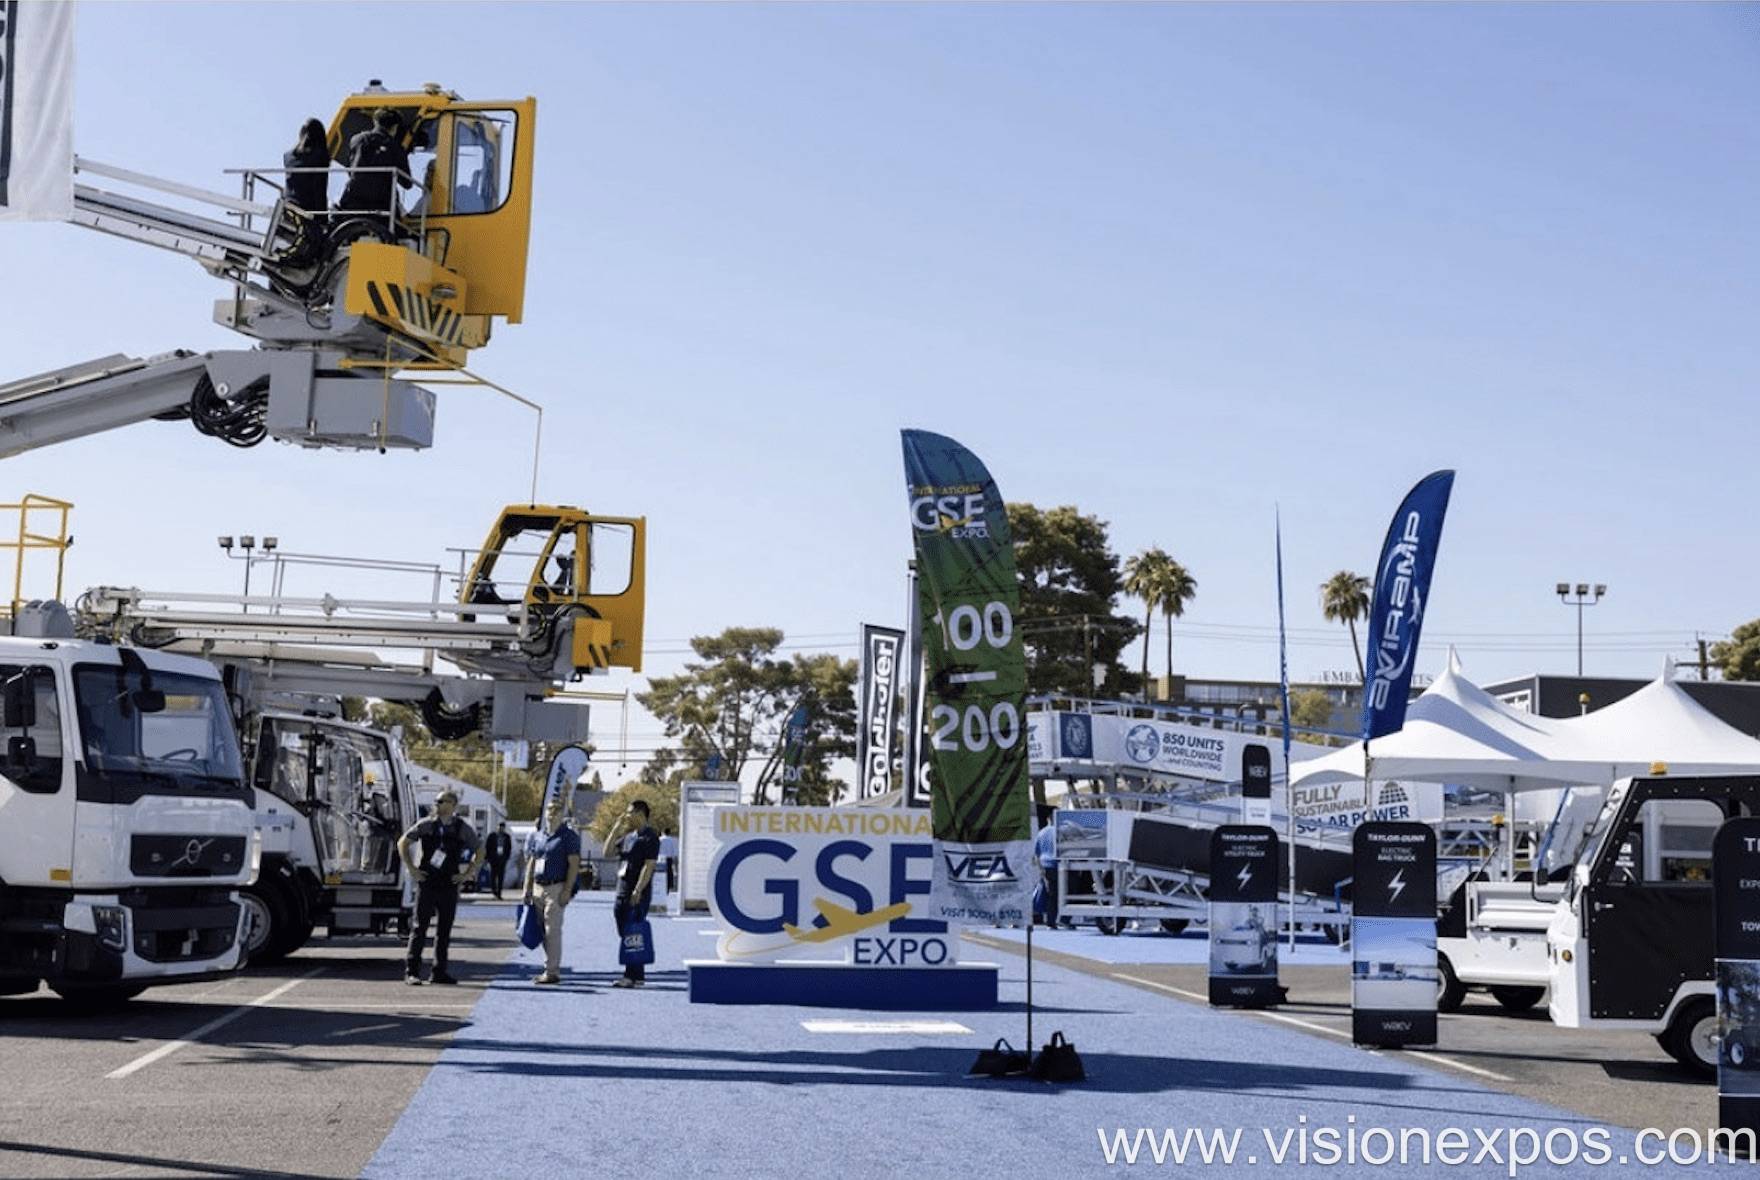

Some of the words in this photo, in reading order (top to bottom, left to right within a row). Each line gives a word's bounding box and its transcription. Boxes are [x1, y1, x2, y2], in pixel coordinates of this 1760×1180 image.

[911, 493, 986, 530] GSE
[951, 527, 988, 538] EXPO
[931, 701, 1020, 752] 200
[1162, 733, 1186, 747] 850
[1187, 736, 1225, 751] UNITS
[1162, 745, 1223, 763] WORLDWIDE
[1294, 784, 1342, 806] FULLY
[1293, 798, 1366, 817] SUSTAINABL
[720, 811, 933, 836] INTERNATIONA
[944, 854, 1015, 878] VEA
[714, 838, 948, 935] GSE
[853, 938, 947, 965] EXPO
